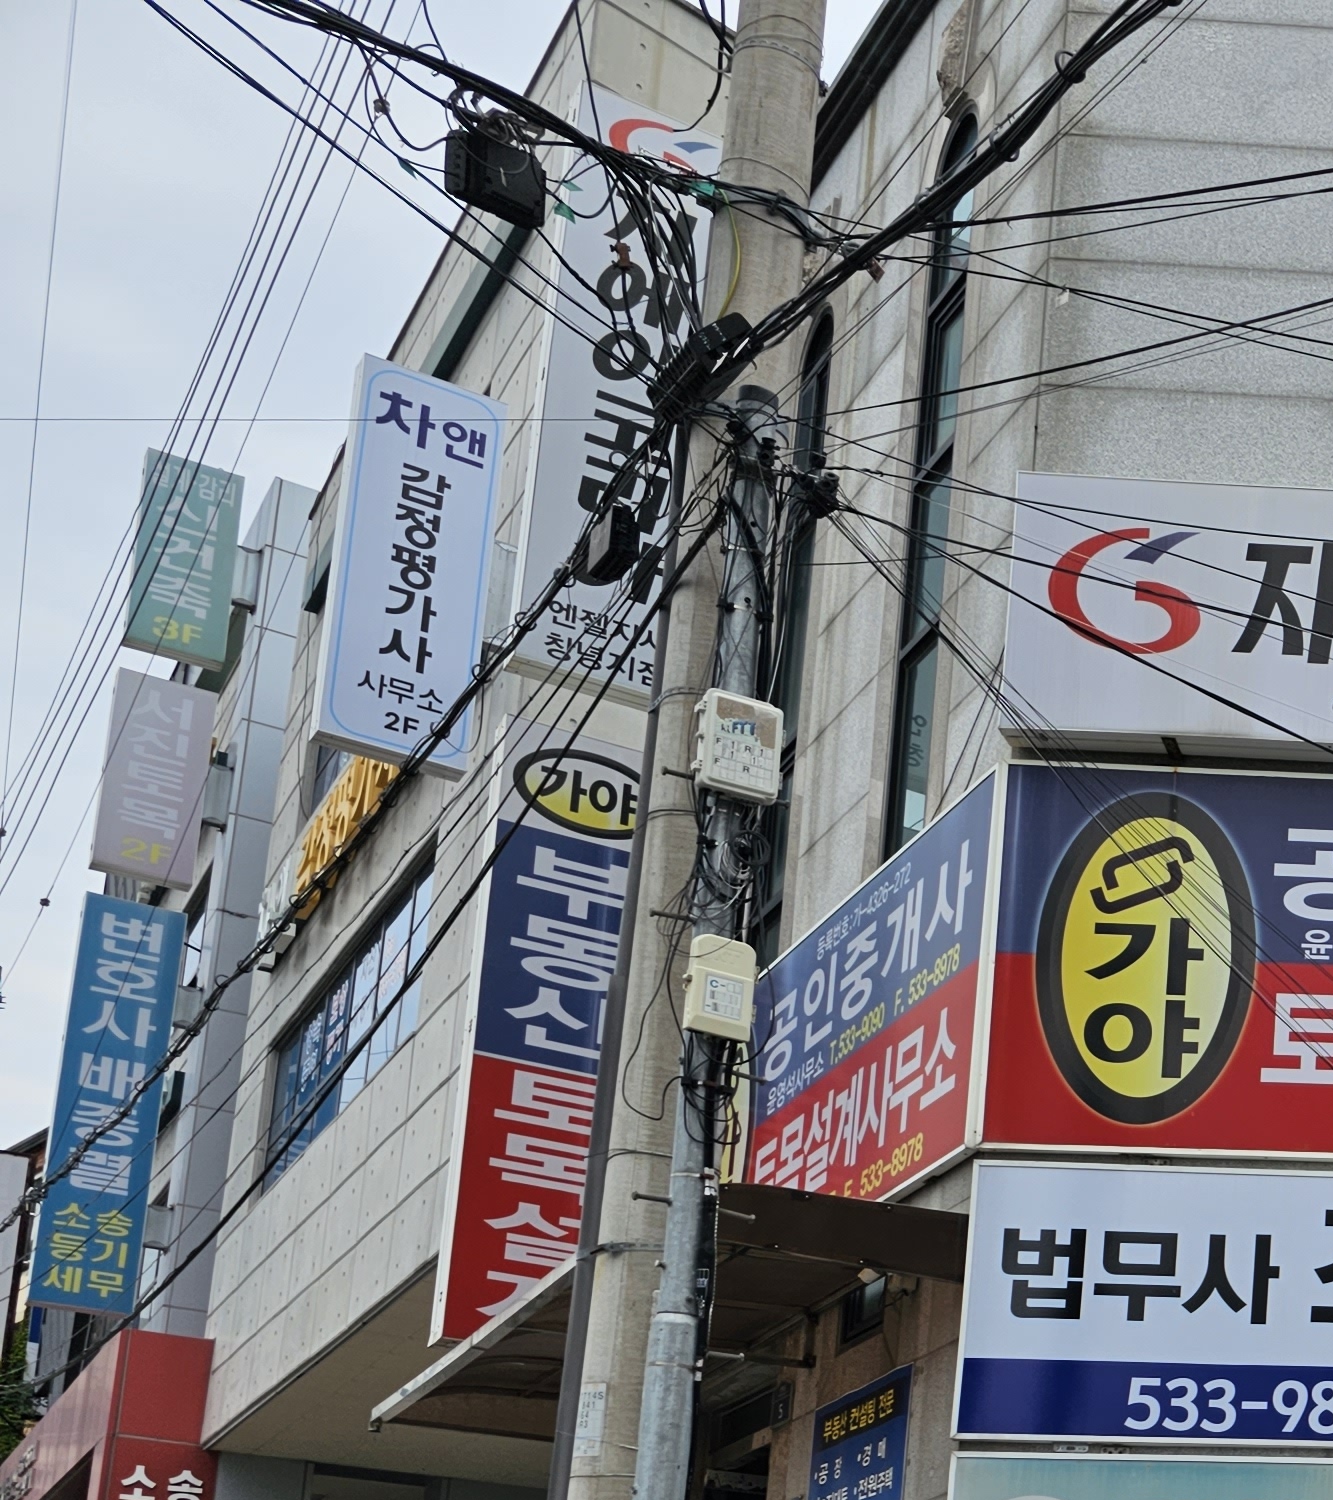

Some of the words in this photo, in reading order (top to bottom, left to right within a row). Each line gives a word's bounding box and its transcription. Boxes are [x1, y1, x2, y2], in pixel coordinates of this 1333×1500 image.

[375, 390, 488, 470] 차앤
[378, 464, 452, 676] 감정평가사
[152, 615, 203, 645] 3F
[356, 668, 444, 717] 사무소
[382, 710, 420, 739] 2F
[120, 836, 171, 865] 2F
[82, 912, 165, 1050] 변호사
[762, 837, 973, 1083] 공인중개사
[907, 942, 961, 1006] 533-8978
[1083, 917, 1205, 1080] 가야
[52, 1202, 133, 1238] 소송
[49, 1233, 129, 1269] 등기
[1000, 1226, 1281, 1326] 법무사
[43, 1265, 124, 1298] 세무
